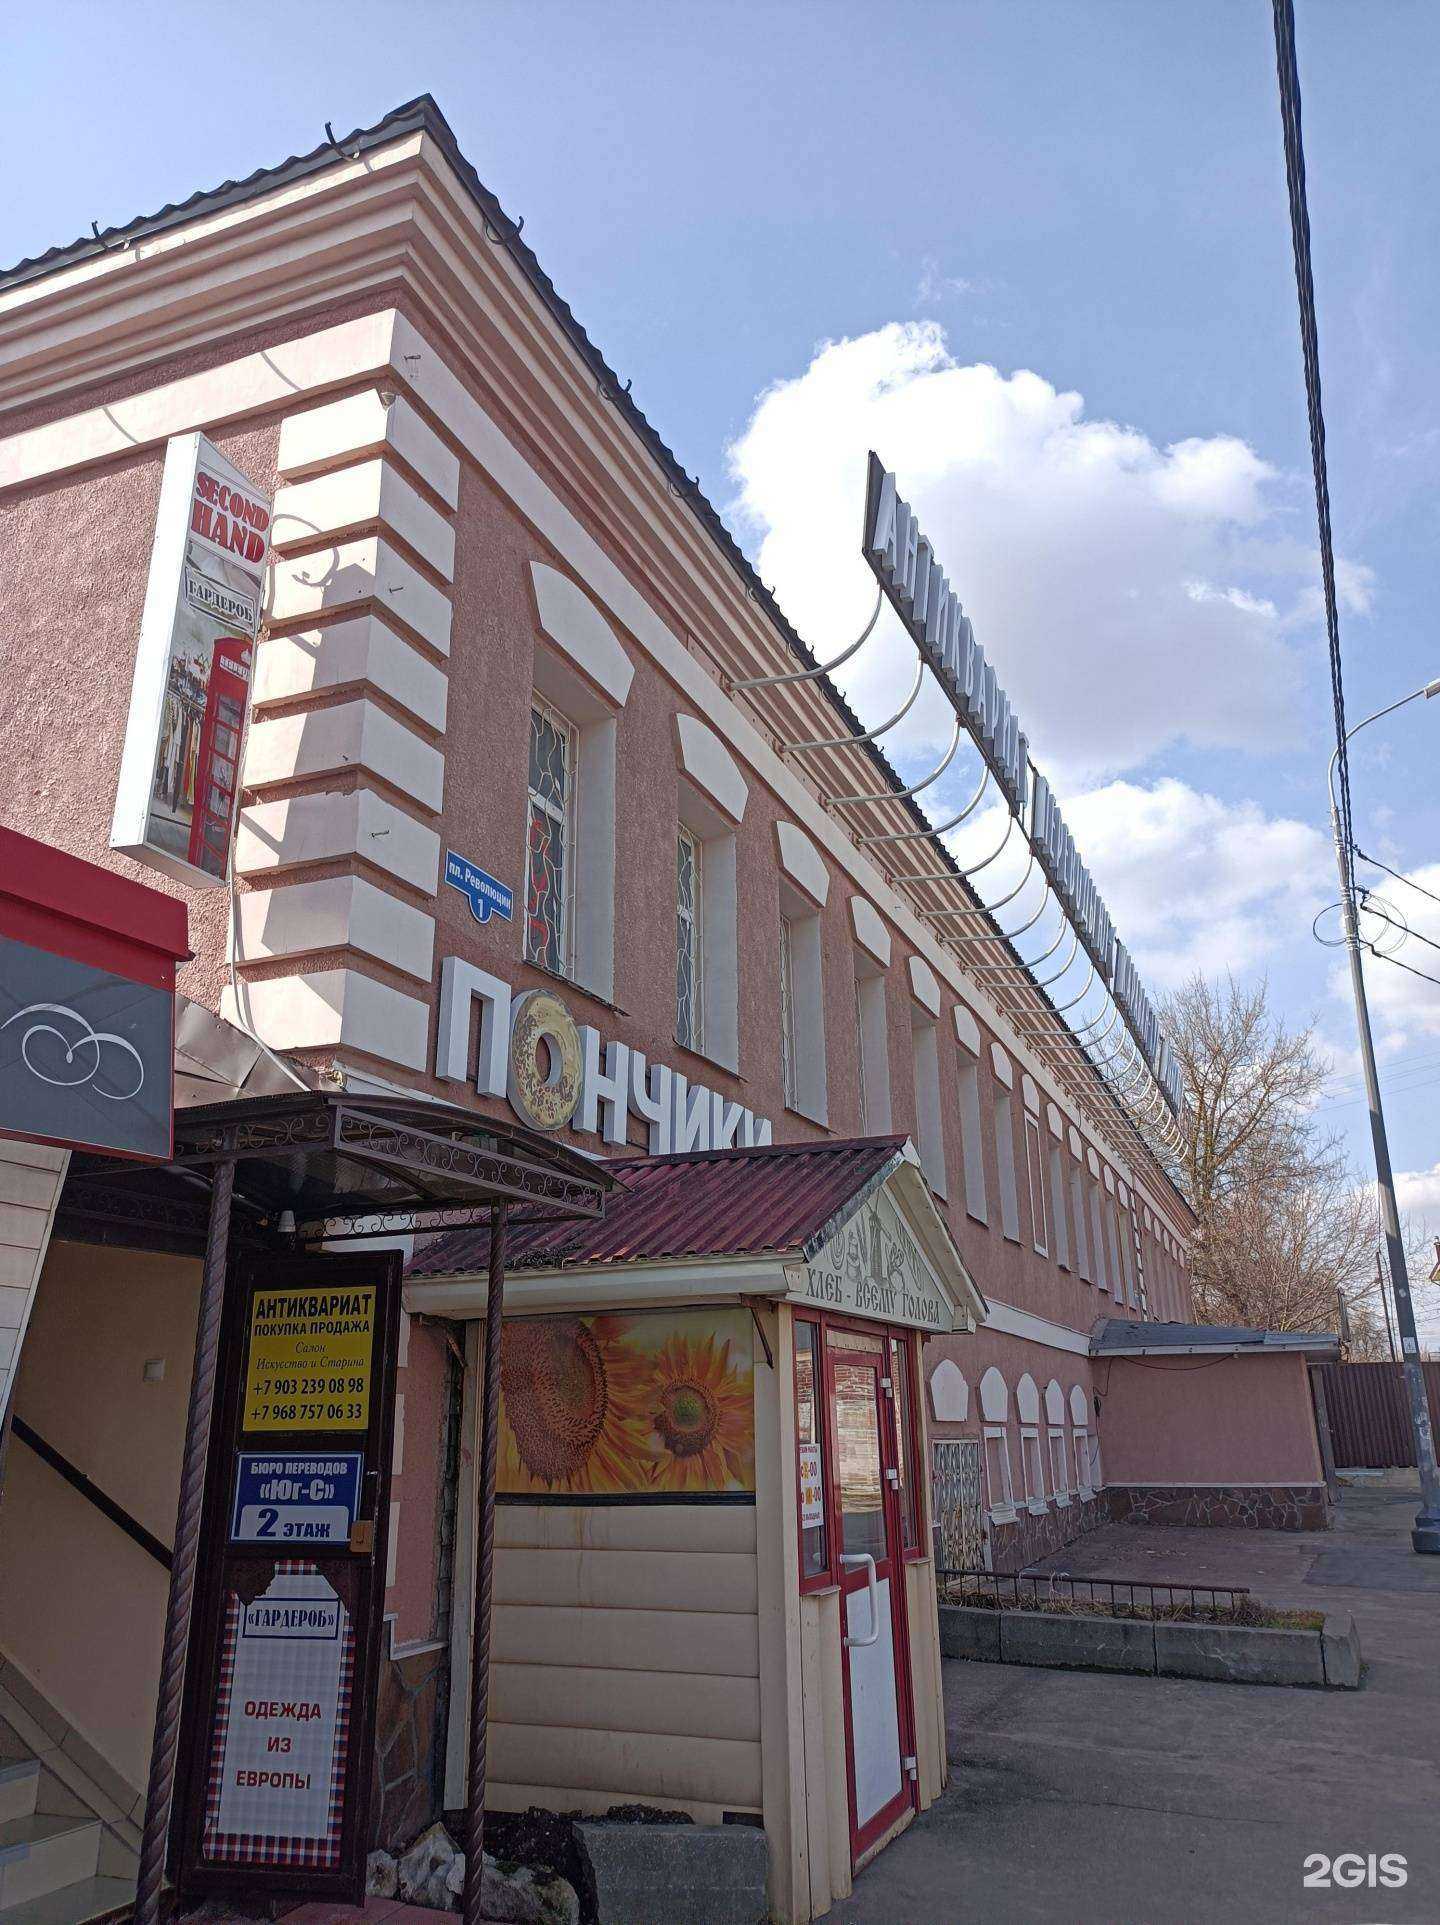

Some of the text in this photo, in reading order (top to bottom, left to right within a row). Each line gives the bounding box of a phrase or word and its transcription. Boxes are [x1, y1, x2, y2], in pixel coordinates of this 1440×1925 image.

[196, 471, 270, 532] SECOND
[191, 499, 266, 563] HAND
[189, 580, 254, 622] ГАРДЕРОБ
[873, 472, 1029, 803] АНТИКВАРИАТ
[448, 862, 511, 910] пл. Революции
[477, 899, 484, 918] 1
[256, 1294, 372, 1319] АНТИКВАРИАТ
[255, 1321, 370, 1336] ПОКУПКА ПРОДАЖА
[295, 1341, 327, 1353] Салон
[256, 1356, 364, 1372] Искусство и Старина
[253, 1378, 364, 1396] +7 903 239 08 98
[251, 1404, 362, 1420] +7 968 757 06 33
[251, 1462, 348, 1476] БЮРО ПЕРЕВОДОВ
[260, 1479, 335, 1501] «Юг-С»
[256, 1507, 279, 1537] 2
[248, 1609, 334, 1628] «ГАРДЕРОБ»
[245, 1701, 322, 1721] ОДЕЖДА
[267, 1736, 292, 1753] ИЗ
[236, 1770, 311, 1790] ЕВРОПЫ
